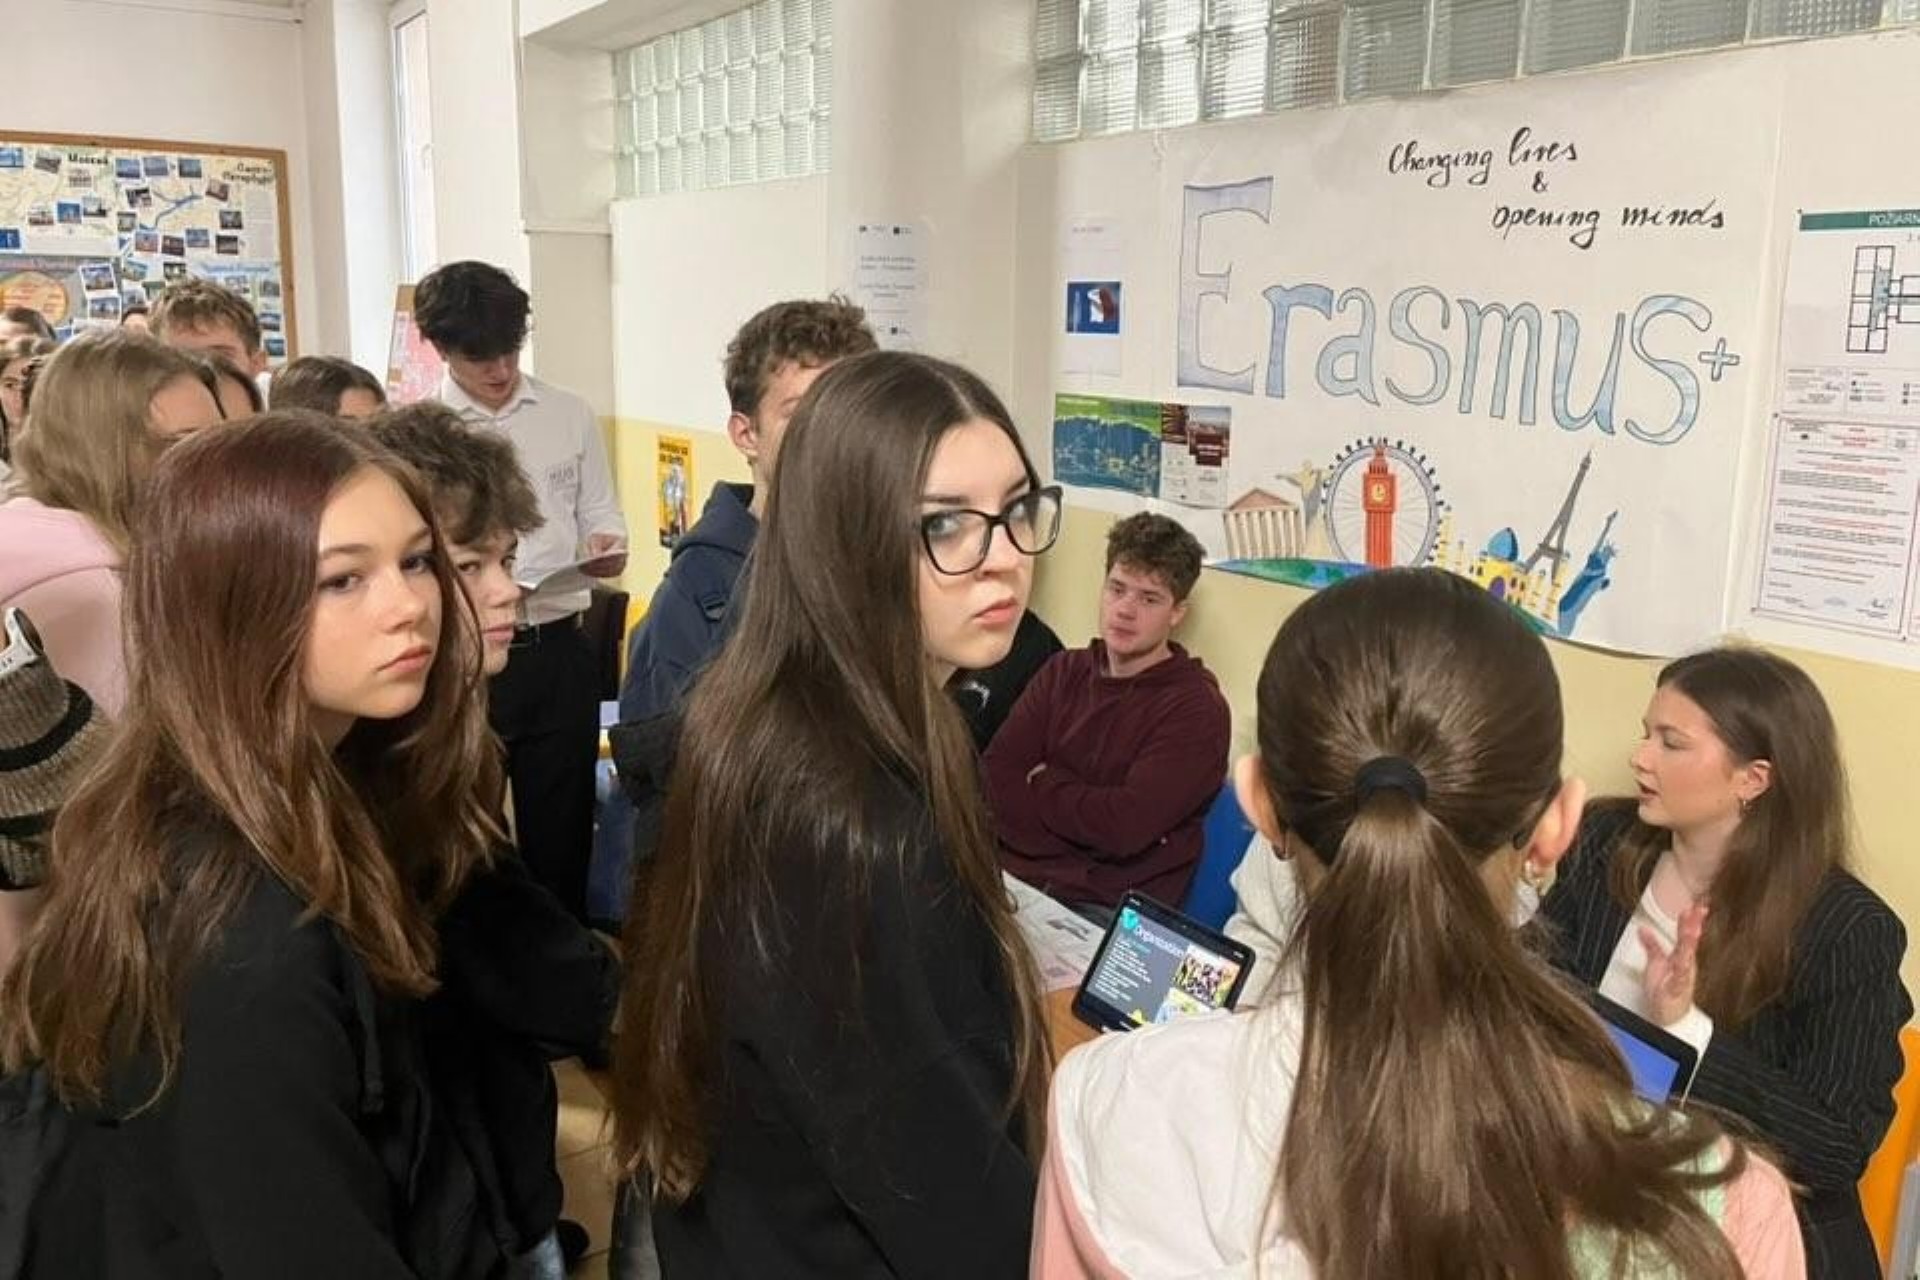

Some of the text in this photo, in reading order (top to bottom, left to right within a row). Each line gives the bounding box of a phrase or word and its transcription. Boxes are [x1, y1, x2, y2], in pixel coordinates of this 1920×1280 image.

[1388, 140, 1493, 188] Changing
[1531, 170, 1549, 193] &
[1620, 198, 1725, 229] minds
